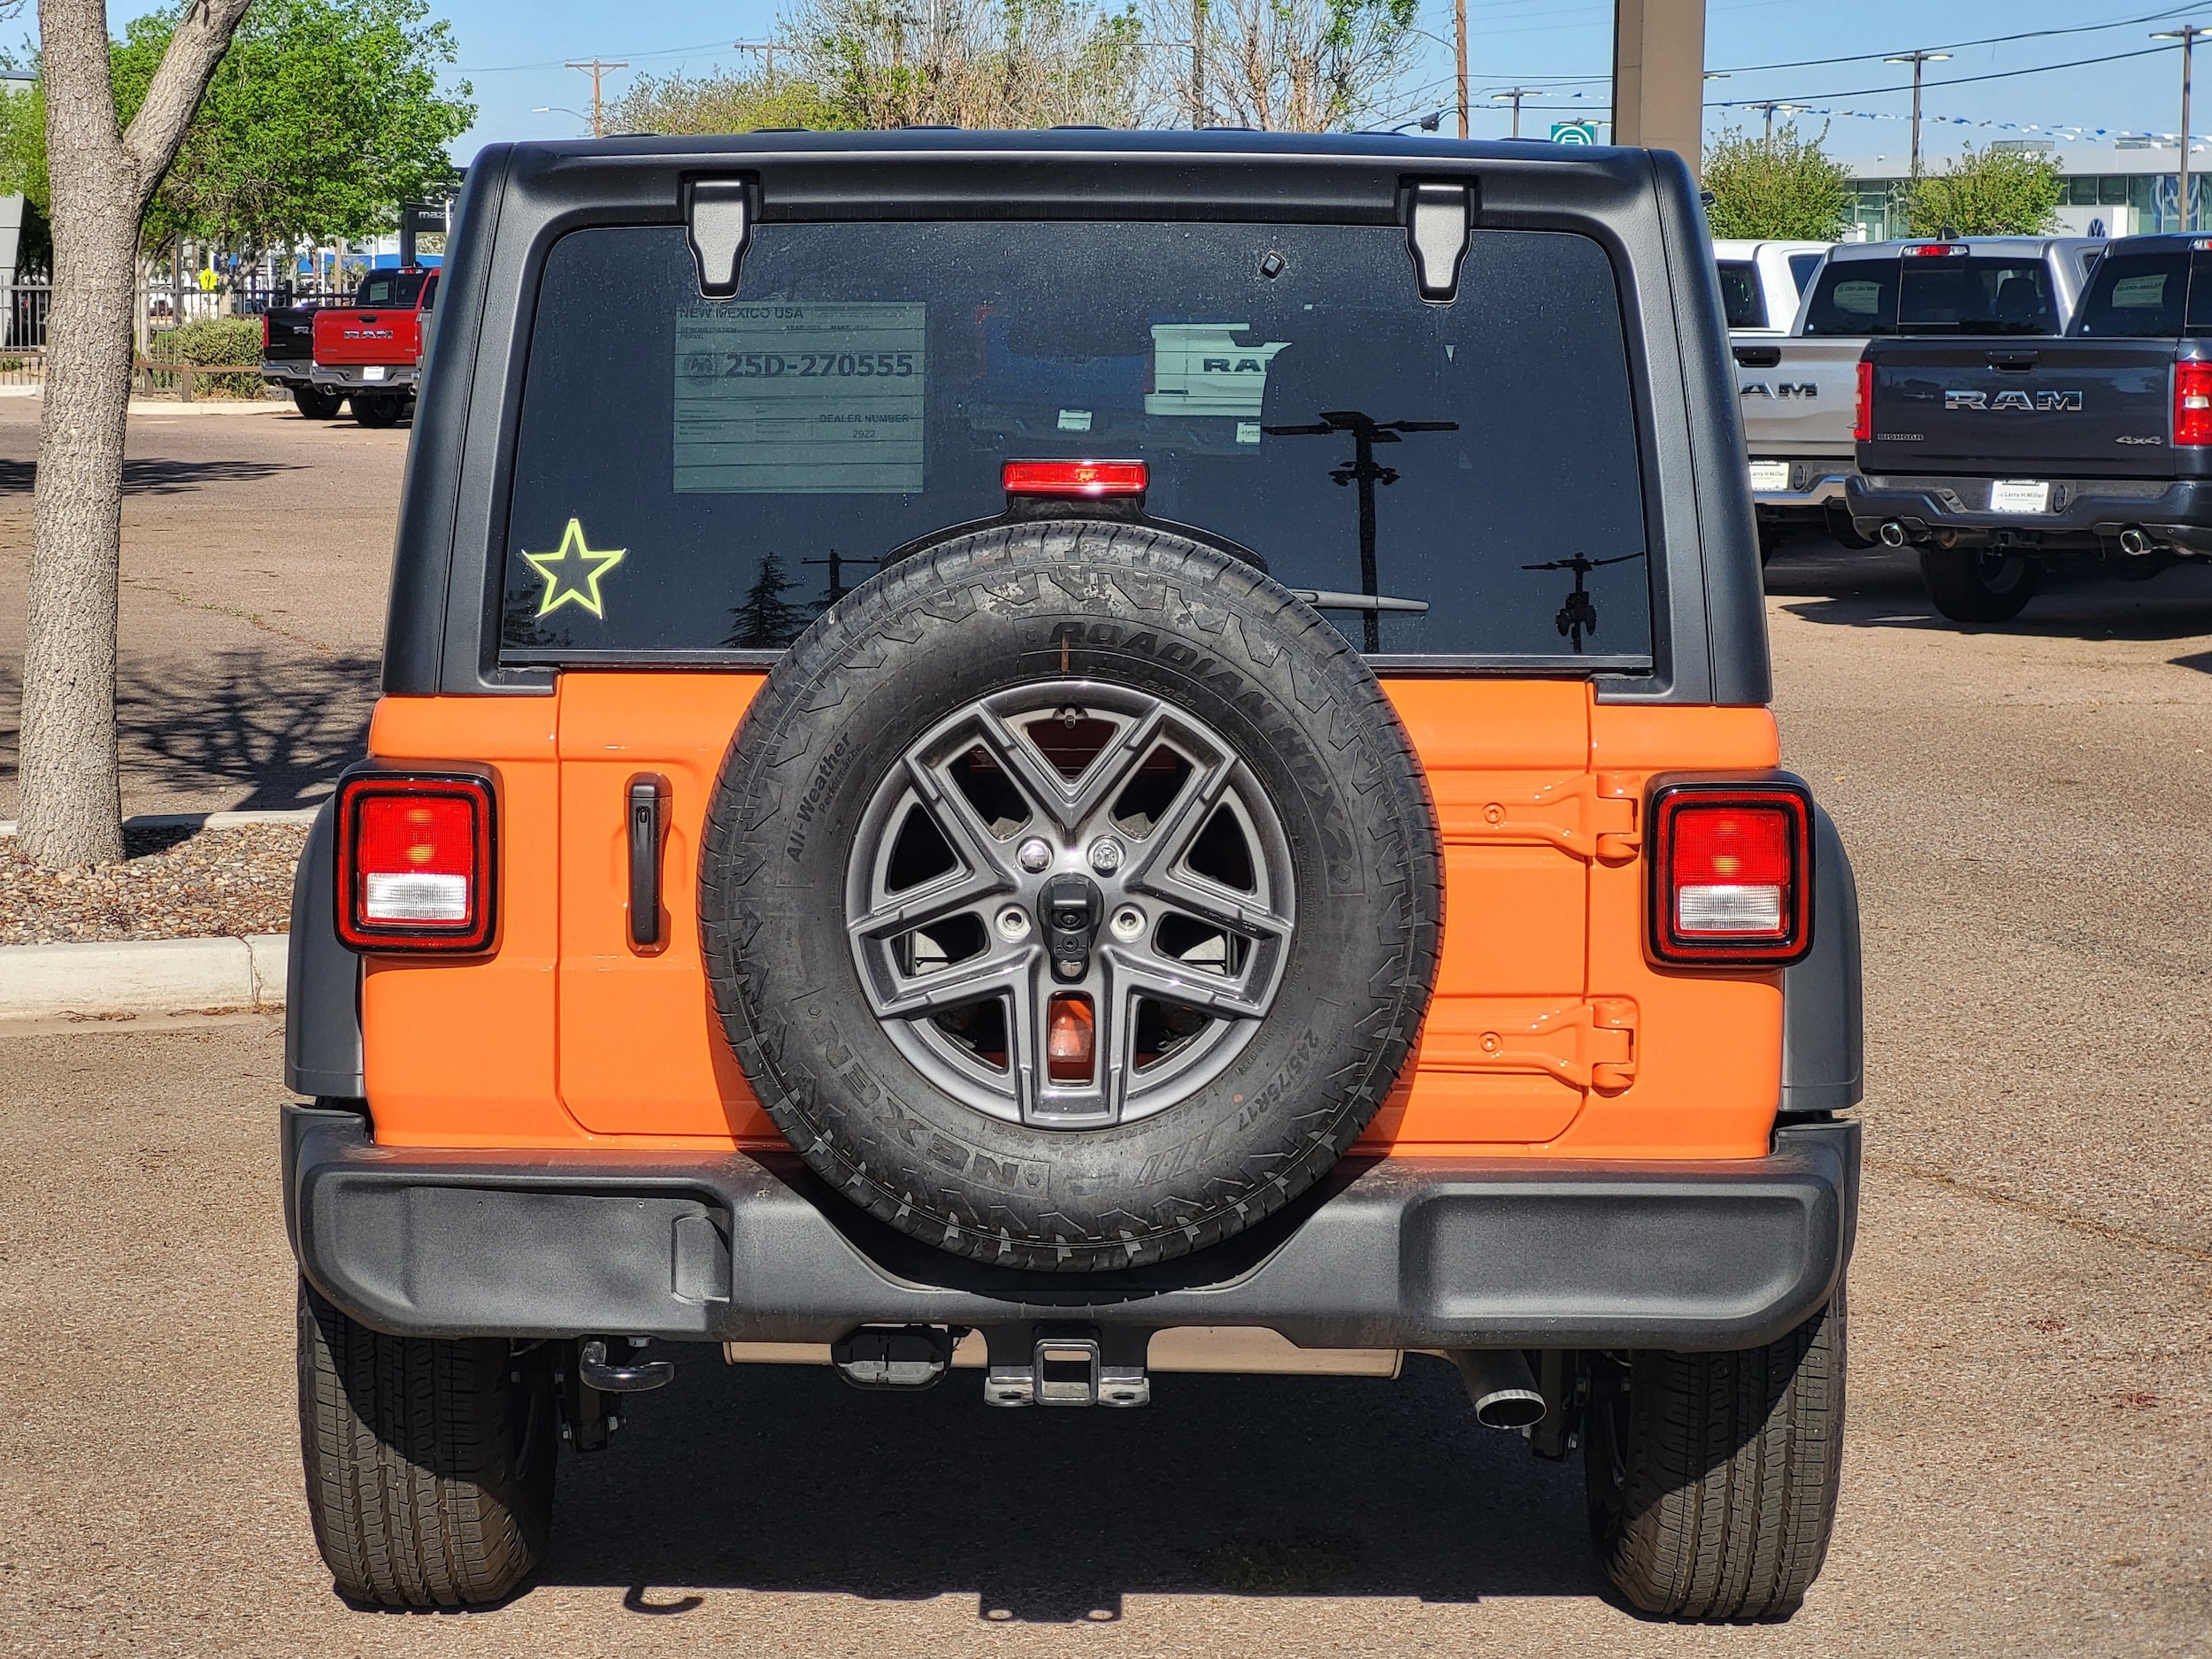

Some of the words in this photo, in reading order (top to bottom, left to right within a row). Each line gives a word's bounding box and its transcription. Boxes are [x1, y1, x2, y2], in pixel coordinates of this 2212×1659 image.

[418, 211, 453, 219] maz
[680, 308, 710, 319] NEW
[715, 308, 770, 319] MEXICO
[774, 308, 804, 319] USA
[346, 330, 393, 340] RAM
[726, 355, 913, 377] 25D-270555
[1740, 381, 1818, 400] AM
[1944, 389, 2084, 412] RAM
[819, 414, 861, 423] DEALER
[864, 413, 909, 423] NUMBER
[852, 430, 875, 439] 2922
[2115, 435, 2163, 446] 4x4
[787, 732, 851, 863] All-Weather
[1239, 1028, 1320, 1132] 245/75R17
[811, 1024, 1018, 1187] NEXEN
